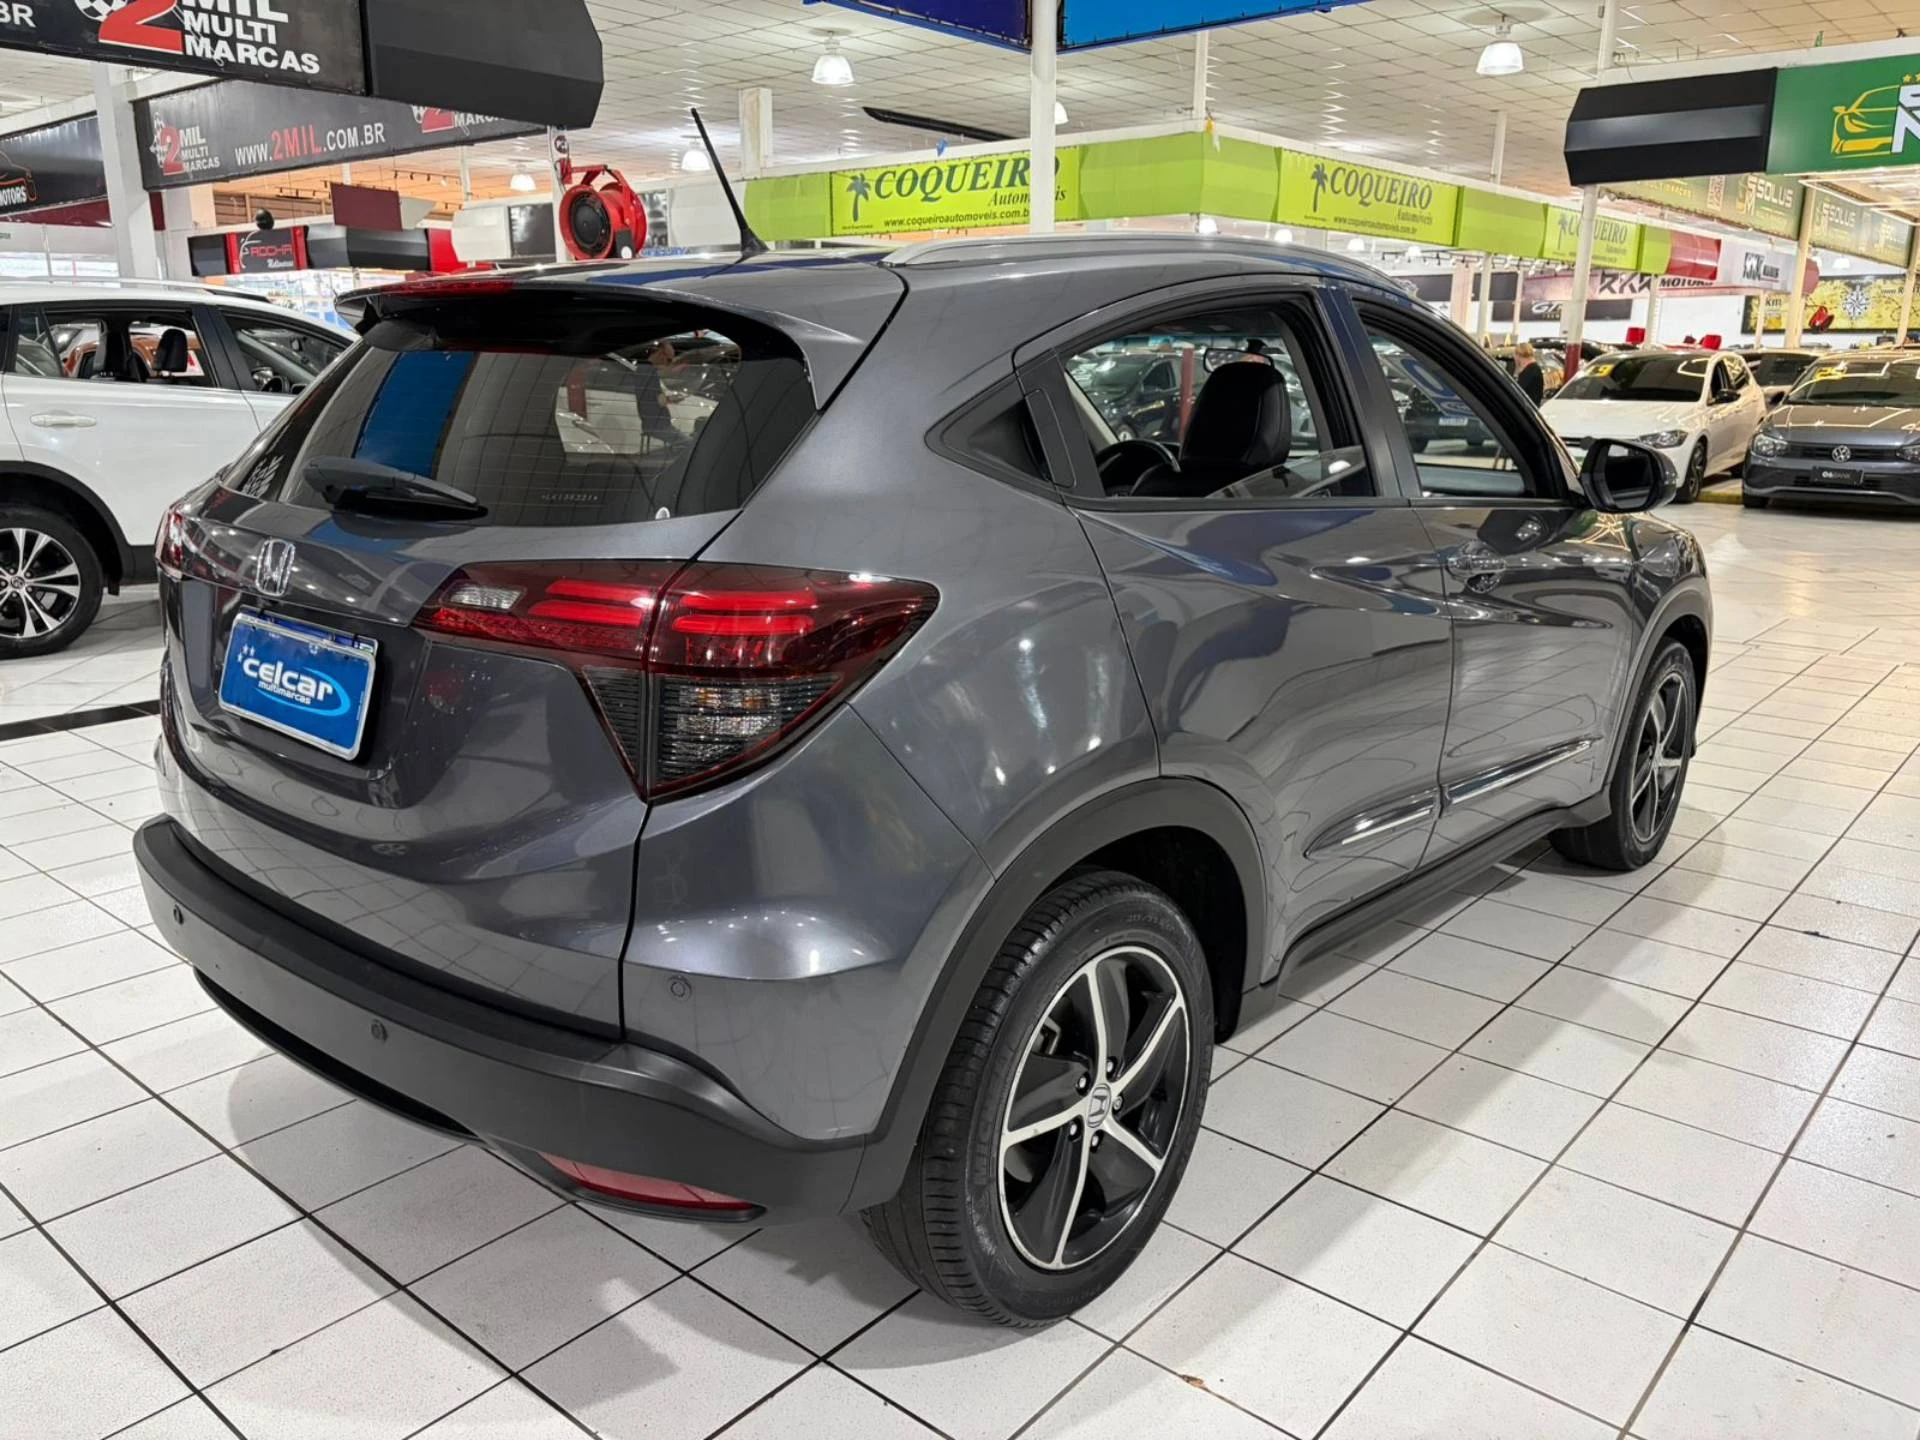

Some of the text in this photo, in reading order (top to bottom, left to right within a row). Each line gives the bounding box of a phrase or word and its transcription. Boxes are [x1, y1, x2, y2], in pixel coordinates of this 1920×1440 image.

[184, 10, 277, 45] MULTI
[185, 34, 320, 74] MARCAS
[179, 126, 206, 147] MIL
[181, 146, 209, 160] MULTI
[874, 156, 1060, 202] COQUEIR
[1330, 166, 1433, 209] COQUEIRO
[883, 208, 1030, 227] www.coqueiroautomoveis.com.b
[243, 660, 334, 702] celcar
[258, 680, 312, 706] multimarcas
